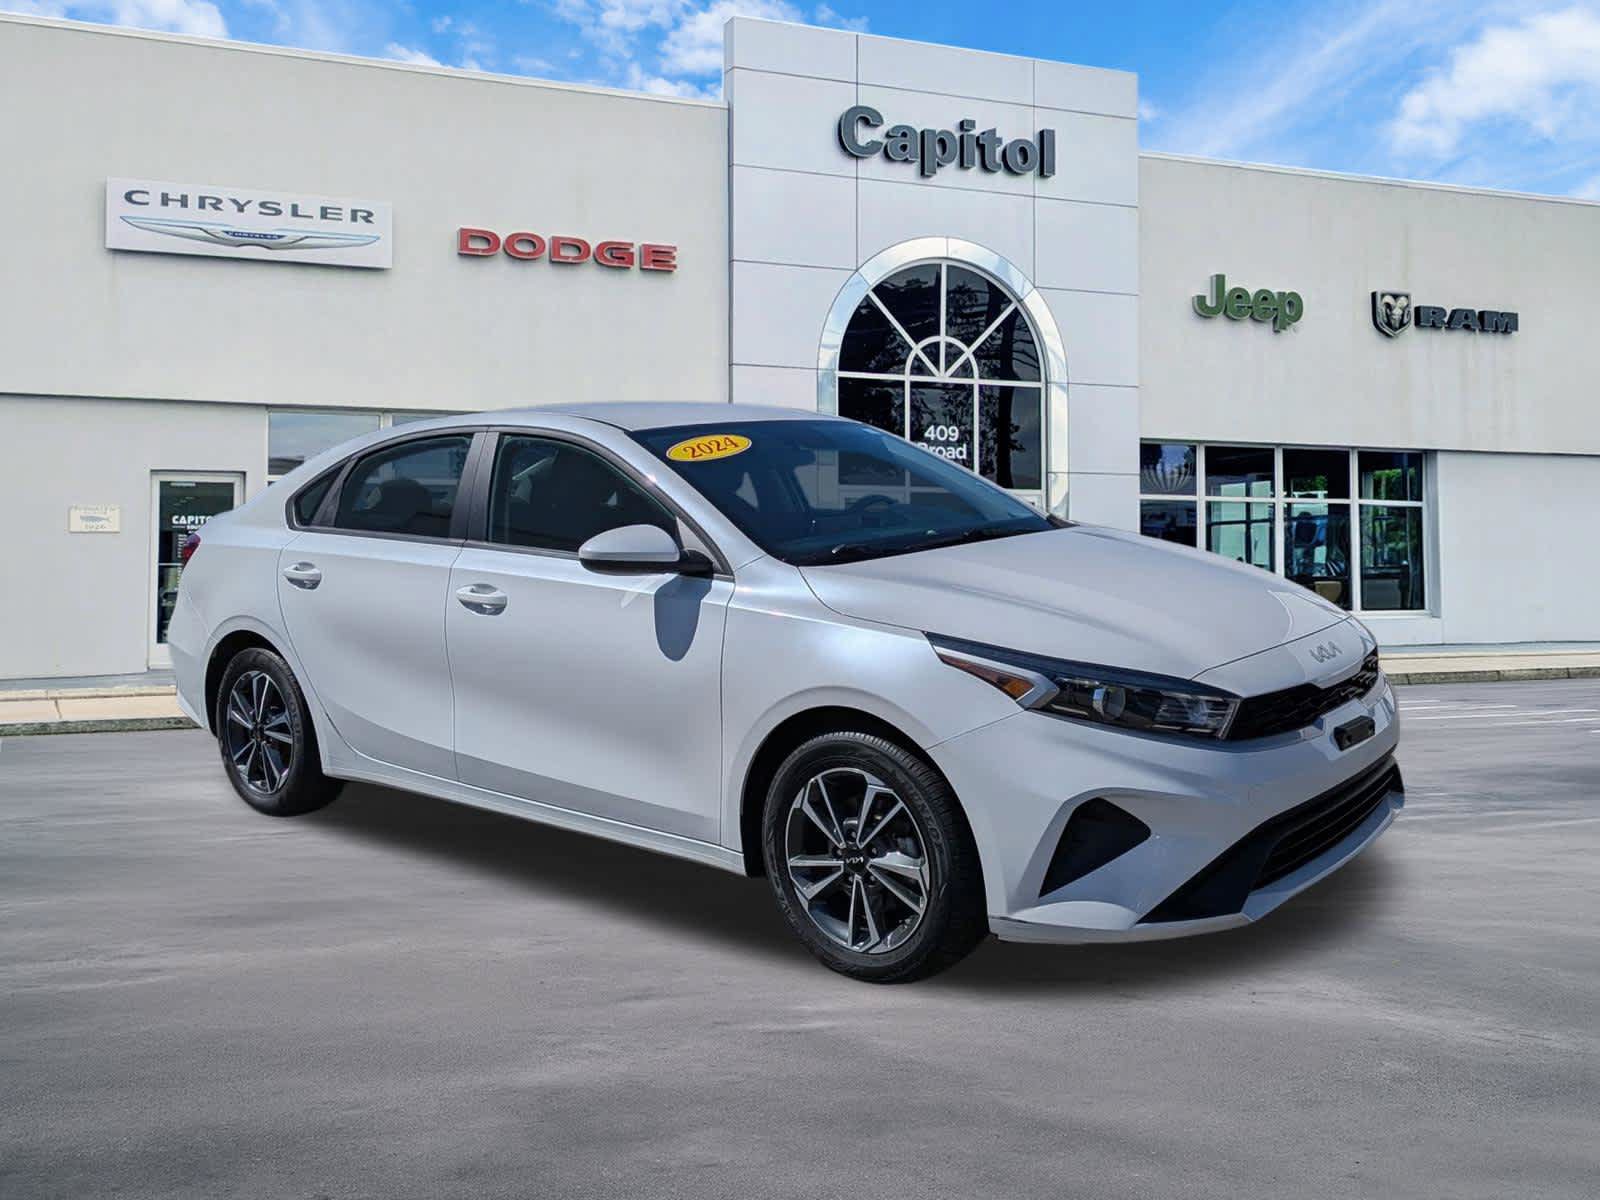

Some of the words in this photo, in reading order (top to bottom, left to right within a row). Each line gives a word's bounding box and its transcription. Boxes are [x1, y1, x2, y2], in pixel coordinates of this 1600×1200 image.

[838, 105, 1055, 177] Capitol
[123, 189, 375, 224] CHRYSLER
[457, 227, 677, 272] DODGE
[1192, 274, 1303, 333] Jeep
[1414, 305, 1518, 334] RAM
[683, 436, 739, 458] 2024
[924, 425, 959, 441] 409
[1309, 641, 1342, 663] KIA
